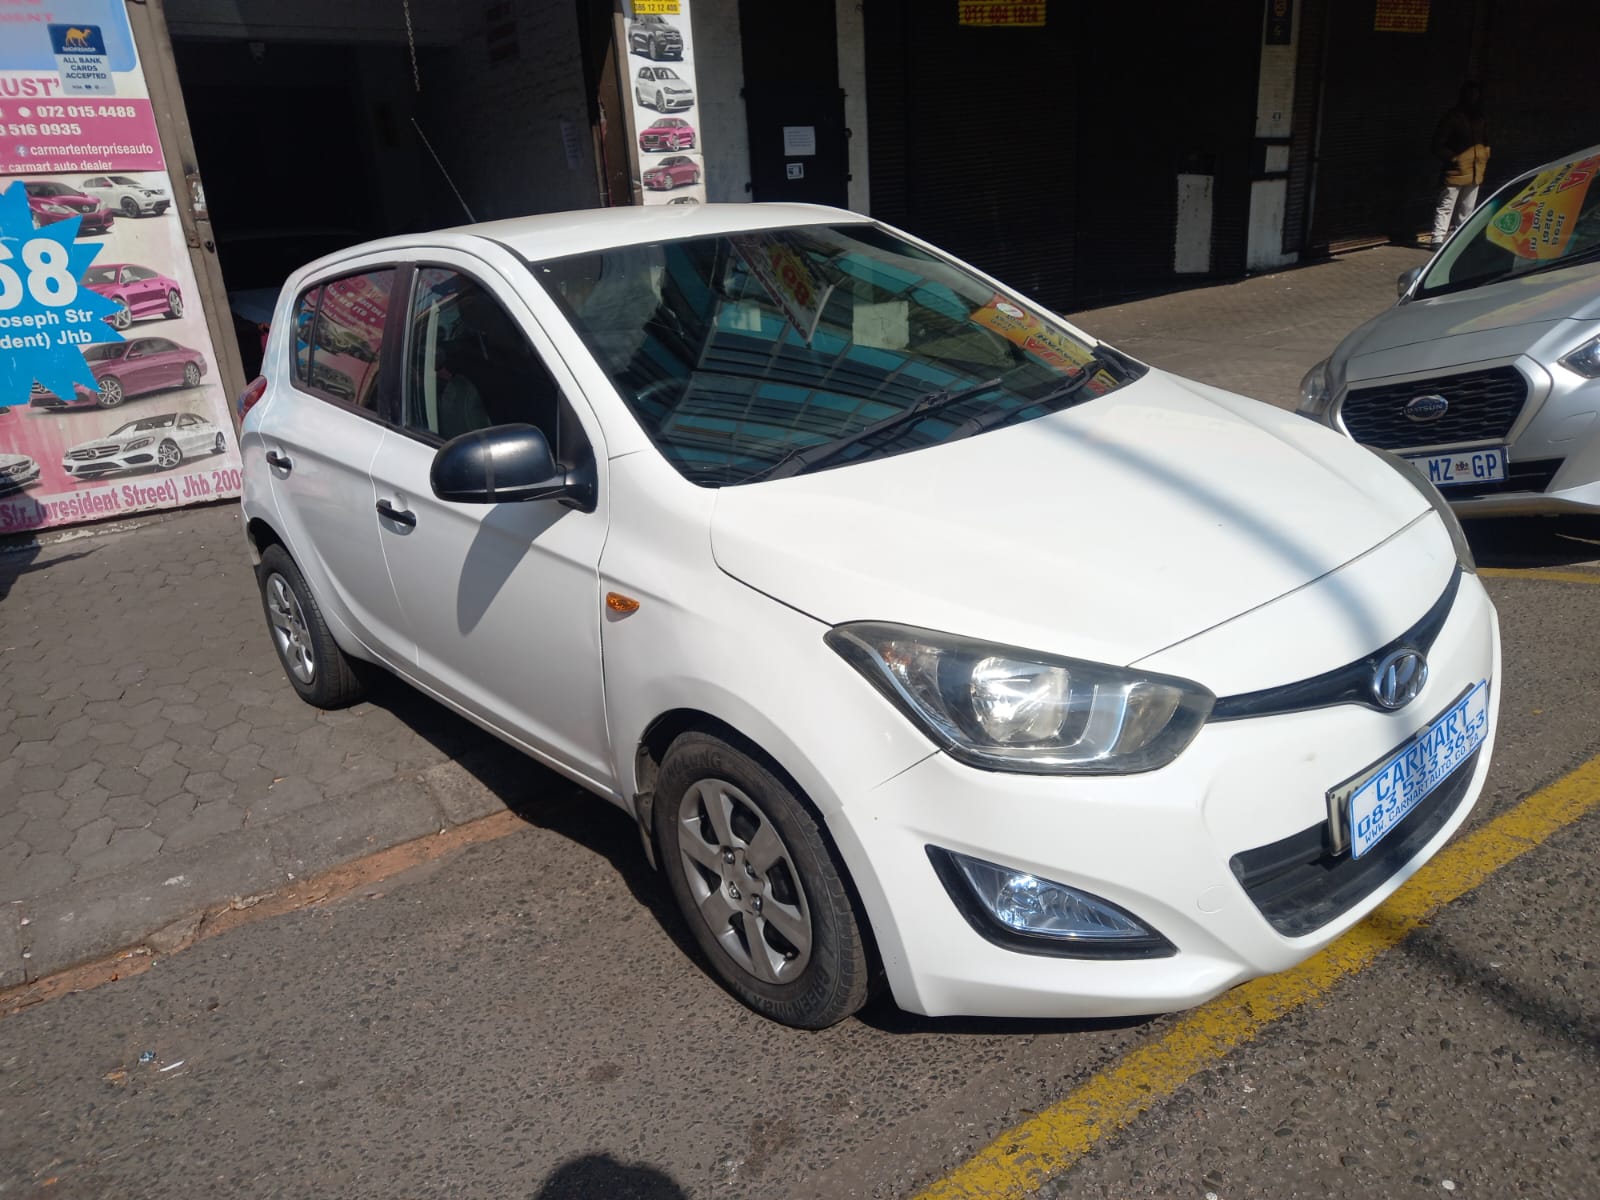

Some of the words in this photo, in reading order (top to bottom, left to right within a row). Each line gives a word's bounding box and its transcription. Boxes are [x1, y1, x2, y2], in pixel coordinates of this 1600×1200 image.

[0, 77, 59, 96] UST'
[37, 105, 65, 117] 072
[8, 123, 37, 136] 516
[40, 123, 81, 135] 0935
[30, 143, 153, 157] carmartenterpriseauto
[9, 162, 50, 172] carmart
[54, 162, 78, 171] auto
[80, 160, 112, 170] dealer
[65, 308, 93, 323] Str
[57, 329, 92, 344] Jhb
[1428, 458, 1454, 481] MZ
[1472, 454, 1497, 478] GP
[122, 478, 179, 507] Street)
[212, 469, 243, 493] 200
[1376, 701, 1470, 801] CARMART
[1358, 791, 1397, 838] 083
[1402, 753, 1438, 797] 533
[1443, 708, 1485, 759] 3653
